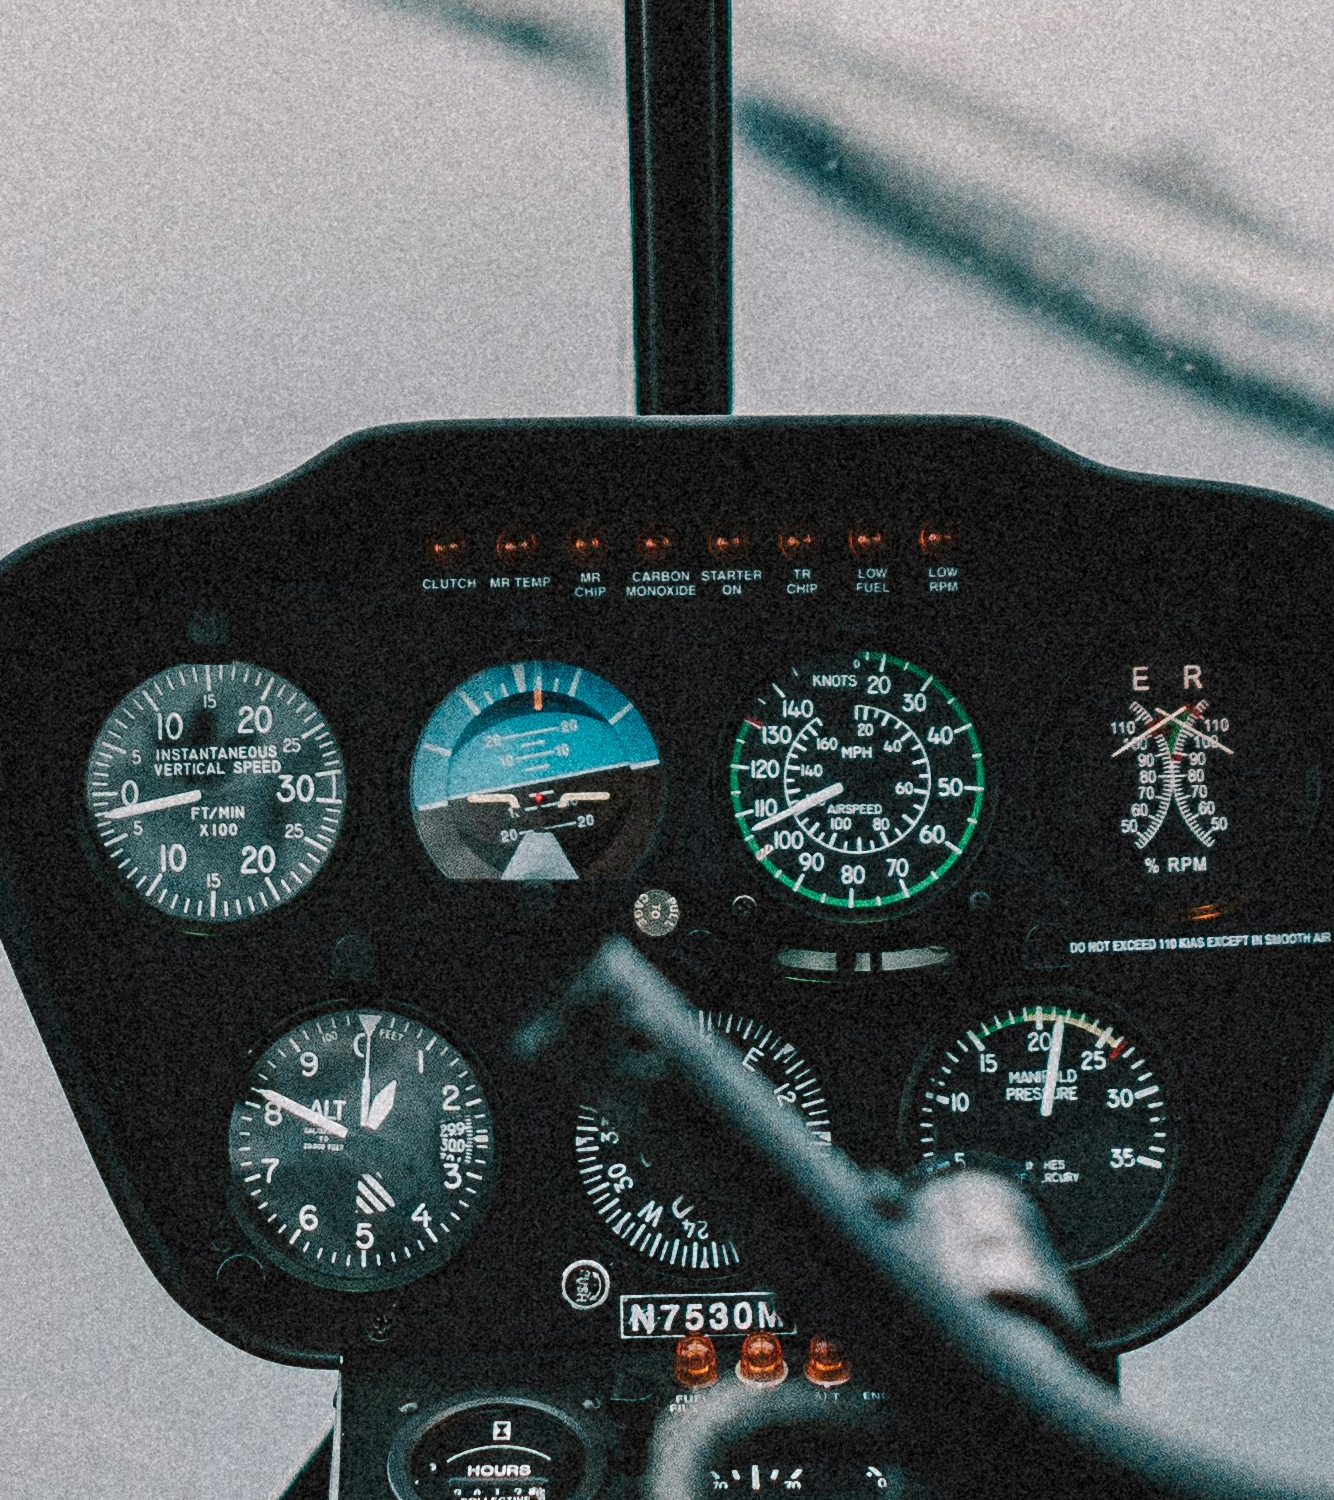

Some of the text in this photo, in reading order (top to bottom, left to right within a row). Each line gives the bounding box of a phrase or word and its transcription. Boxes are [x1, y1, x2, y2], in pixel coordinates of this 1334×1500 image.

[580, 572, 601, 584] MR
[632, 571, 690, 583] CARBON
[701, 570, 762, 582] STARTER
[794, 569, 811, 580] TR
[858, 568, 888, 579] LOW
[928, 567, 958, 578] LOW
[422, 578, 476, 590] CLUTCH
[490, 576, 551, 589] MR TEMP
[722, 584, 742, 595] ON
[787, 582, 818, 594] CHIP
[856, 581, 890, 593] FUEL
[929, 580, 959, 592] RPM
[575, 586, 606, 598] CHIP
[626, 585, 696, 597] MONOXIDE
[812, 675, 857, 688] KNOTS
[867, 676, 891, 695] 20
[1132, 665, 1202, 692] E R
[203, 694, 217, 709] 15
[782, 699, 814, 719] 140
[902, 693, 927, 712] 30
[157, 712, 183, 740] 10
[237, 705, 272, 734] 20
[1204, 719, 1229, 732] 110
[762, 726, 792, 745] 130
[858, 724, 873, 737] 20
[927, 726, 954, 745] 40
[1111, 721, 1136, 735] 110
[282, 738, 302, 754] 25
[816, 738, 838, 751] 160
[883, 740, 902, 753] 40
[132, 751, 142, 765] 5
[156, 745, 277, 761] INSTANTANEOUS
[841, 747, 872, 759] MPH
[1189, 753, 1206, 766] 90
[154, 760, 282, 777] VERTICAL SPEED
[1138, 754, 1155, 768] 90
[750, 760, 780, 778] 120
[800, 765, 823, 777] 140
[1187, 769, 1204, 783] 80
[1139, 770, 1156, 784] 80
[121, 780, 139, 805] 0
[276, 774, 315, 803] 30
[895, 782, 913, 795] 60
[938, 778, 963, 797] 50
[1139, 786, 1155, 800] 70
[1191, 785, 1207, 798] 70
[191, 806, 245, 821] FT/MIN
[755, 799, 778, 818] 110
[827, 804, 882, 815] AIRSPEED
[1131, 804, 1148, 817] 60
[1198, 802, 1215, 815] 60
[133, 821, 143, 836] 5
[577, 814, 594, 828] 20
[830, 818, 852, 831] 100
[873, 818, 889, 831] 80
[1121, 819, 1138, 834] 50
[1210, 817, 1228, 831] 50
[285, 824, 305, 839] 25
[500, 828, 518, 843] 20
[919, 825, 945, 844] 60
[773, 830, 804, 849] 100
[160, 843, 187, 873] 10
[241, 845, 276, 874] 20
[799, 853, 825, 872] 90
[1145, 856, 1207, 873] % RPM
[841, 865, 866, 884] 80
[886, 859, 909, 878] 70
[206, 873, 221, 889] 15
[1070, 942, 1085, 953] DO
[1088, 941, 1110, 952] NOT
[1112, 939, 1156, 951] EXCEED
[1207, 935, 1249, 947] EXCEPT
[1252, 934, 1262, 945] IN
[1265, 933, 1312, 945] SMOOTH
[1313, 932, 1331, 943] AIR
[379, 1028, 404, 1041] FEET
[1027, 1032, 1052, 1052] 20
[299, 1051, 319, 1077] 9
[741, 1046, 764, 1073] E
[980, 1053, 998, 1073] 15
[1080, 1050, 1107, 1071] 25
[1008, 1069, 1078, 1084] MANIFLD
[442, 1084, 461, 1111] 2
[774, 1082, 797, 1108] 12
[1006, 1086, 1078, 1101] PRESURE
[1106, 1088, 1134, 1109] 30
[951, 1092, 969, 1112] 10
[264, 1100, 283, 1127] 8
[310, 1098, 347, 1122] ALT
[1110, 1147, 1136, 1168] 35
[261, 1158, 280, 1184] 7
[443, 1163, 462, 1190] 3
[608, 1162, 634, 1193] 30
[299, 1204, 319, 1231] 6
[411, 1202, 432, 1228] 4
[637, 1200, 664, 1228] W
[355, 1222, 374, 1250] 5
[681, 1218, 709, 1240] 24
[630, 1301, 783, 1334] N7530M
[468, 1464, 531, 1477] HOURS
